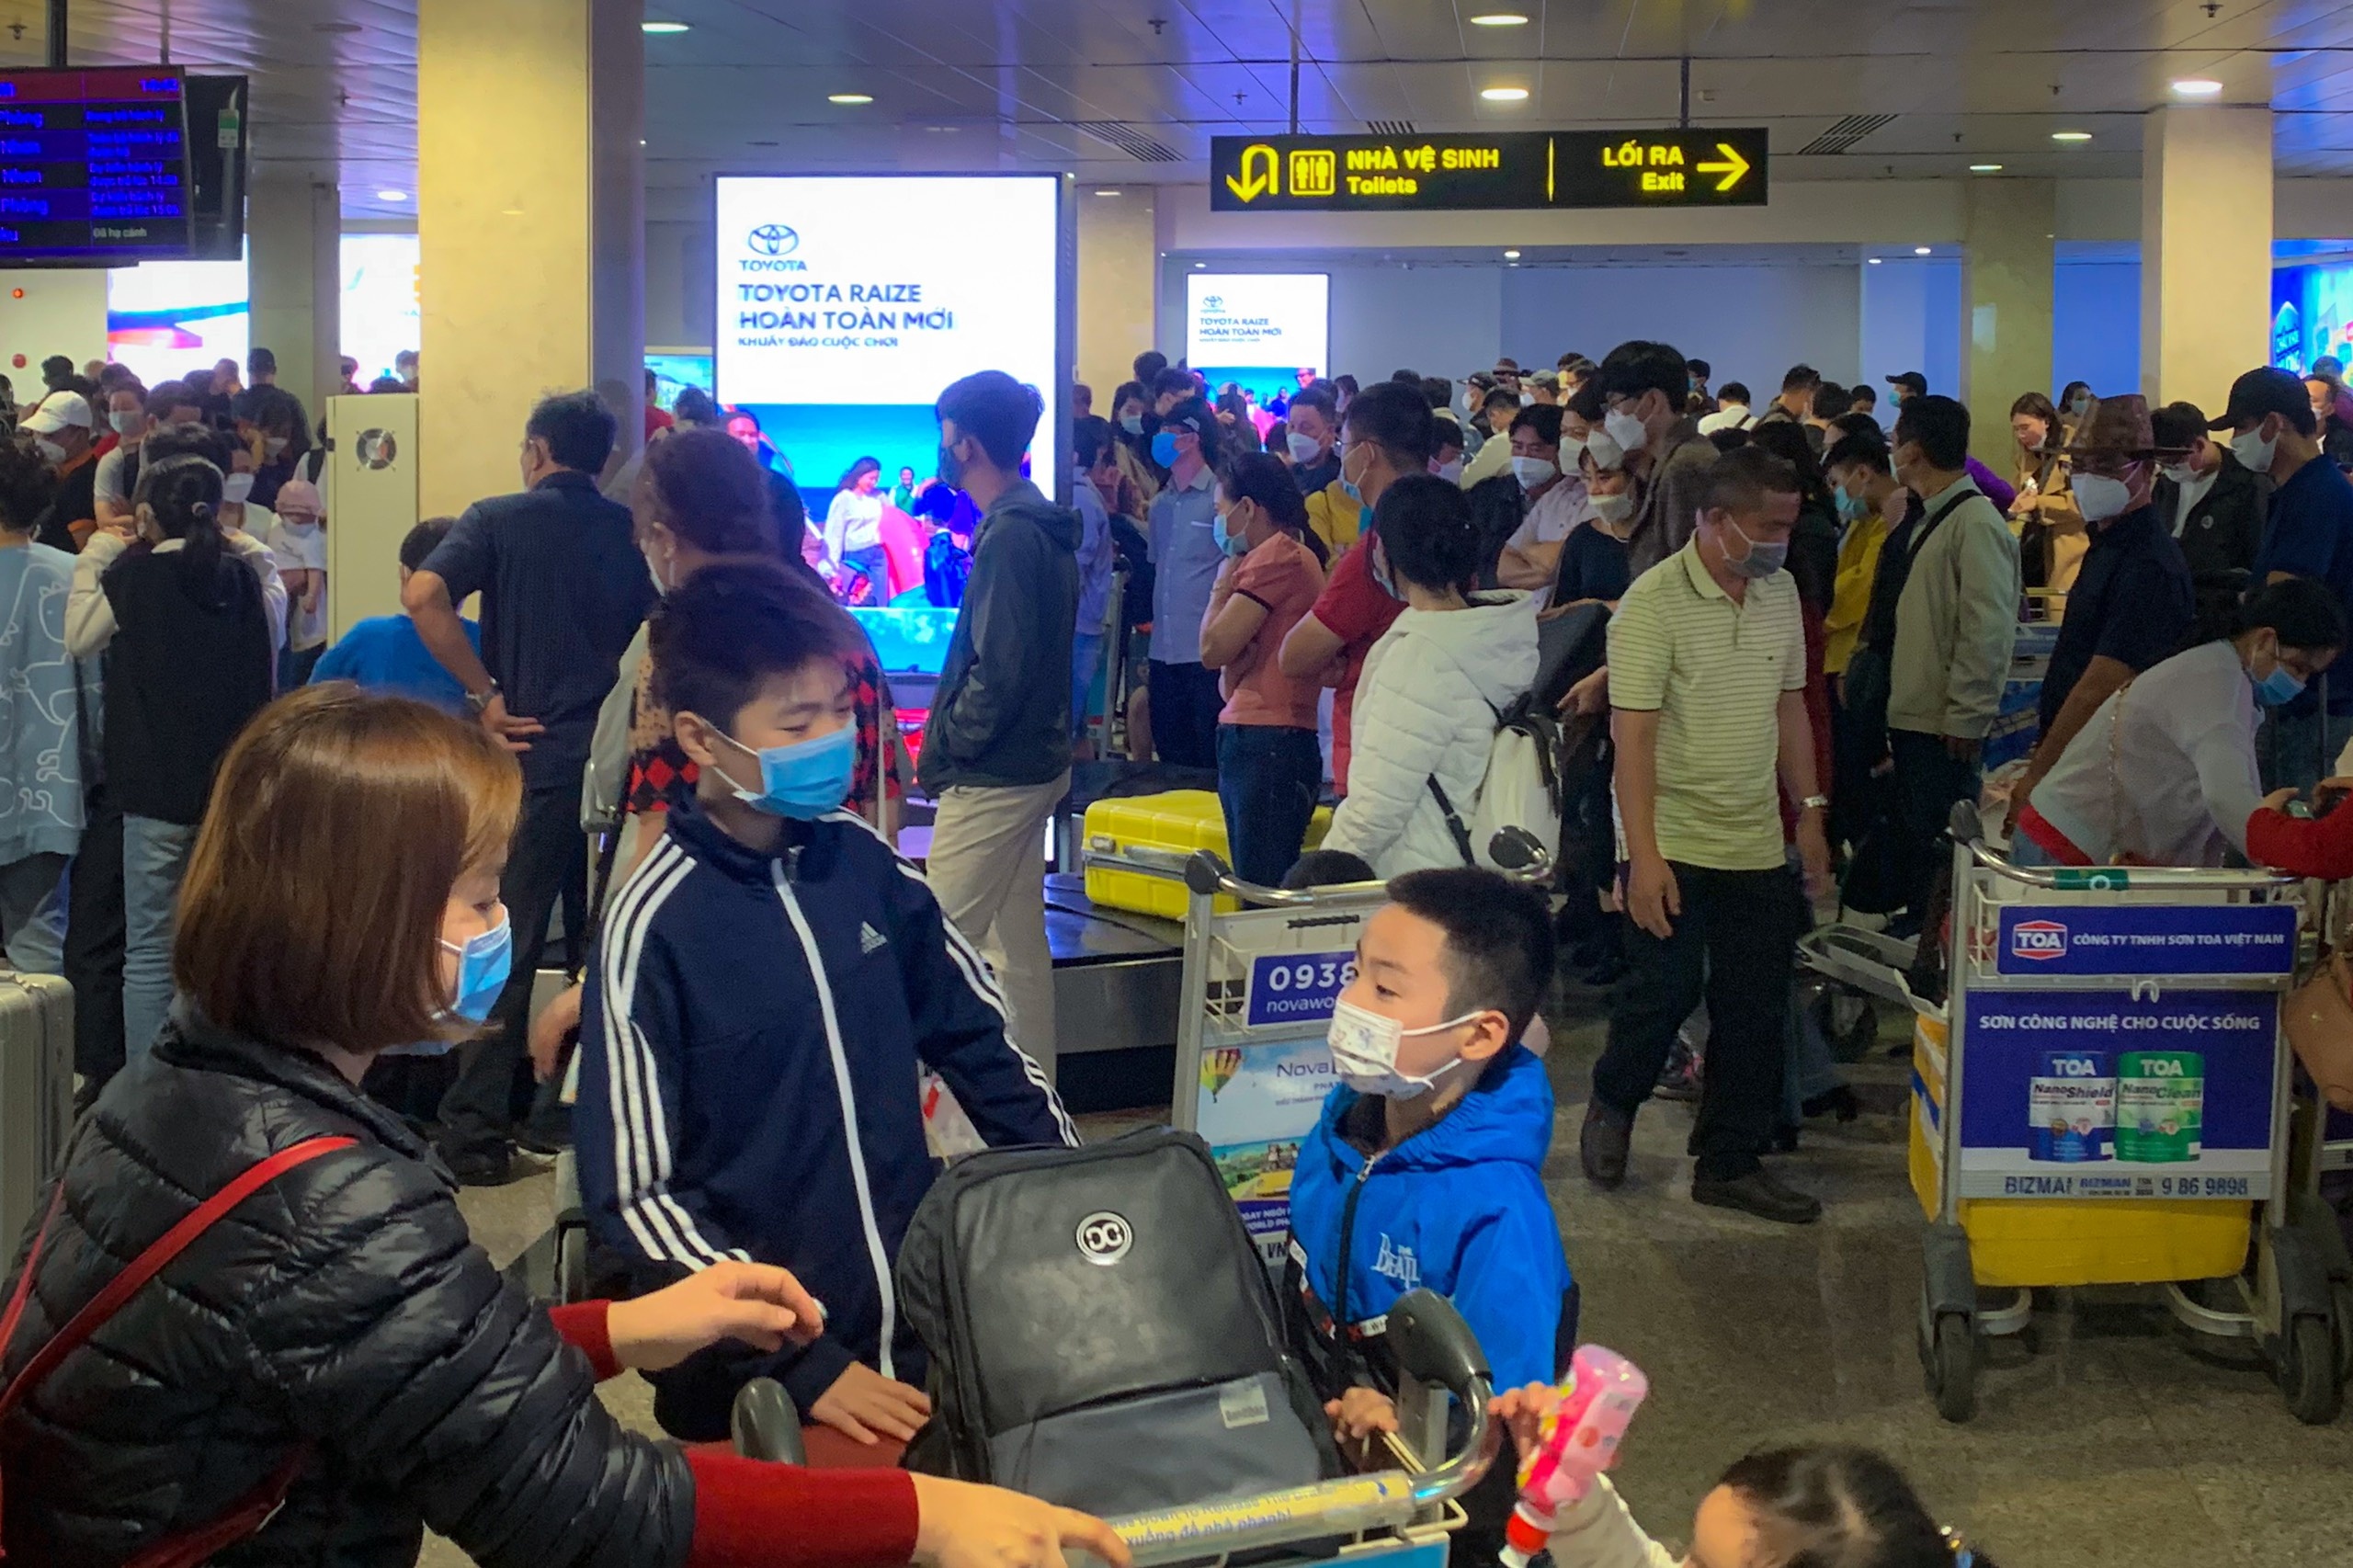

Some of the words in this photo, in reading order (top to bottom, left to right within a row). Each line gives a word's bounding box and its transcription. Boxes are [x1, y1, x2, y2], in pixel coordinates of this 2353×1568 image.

[1347, 145, 1398, 170] NHÀ
[1404, 144, 1436, 173] VỆ
[1442, 148, 1500, 169] SINH
[1604, 140, 1643, 166] LỐI
[1650, 146, 1685, 165] RA
[1347, 176, 1418, 195] Toilets
[1643, 172, 1685, 191] Exit
[738, 259, 808, 272] TOYOTA
[738, 283, 843, 303] TOYOTA
[849, 283, 922, 303] RAIZE
[739, 306, 817, 330] HOÀN
[823, 306, 897, 330] TOÀN
[903, 307, 954, 330] MỚI
[1199, 326, 1230, 335] HOÀN
[1232, 326, 1260, 335] TOÀN
[822, 335, 860, 350] CUỘC
[864, 336, 898, 347] CHƠI
[2018, 932, 2062, 949] TOA
[2073, 933, 2110, 946] CÔNG
[2112, 935, 2129, 946] TY
[2131, 935, 2165, 946] TNHH
[2168, 934, 2196, 946] SƠN
[2198, 935, 2222, 945] TOA
[2224, 933, 2252, 947] VIỆT
[2255, 934, 2285, 944] NAM
[1268, 960, 1357, 992] 0938
[1267, 996, 1335, 1013] novawo
[1979, 1014, 2016, 1029] SƠN
[2018, 1013, 2067, 1029] CÔNG
[2071, 1013, 2119, 1033] NGHỆ
[2121, 1016, 2158, 1029] CHO
[2161, 1014, 2209, 1033] CUỘC
[2211, 1011, 2260, 1029] SỐNG
[2052, 1059, 2097, 1076] TOA
[2141, 1059, 2185, 1076] TOA
[2034, 1083, 2115, 1099] NanoShield
[2121, 1083, 2201, 1099] NanoClean
[2177, 1177, 2200, 1195] 86
[2205, 1176, 2249, 1196] 9898
